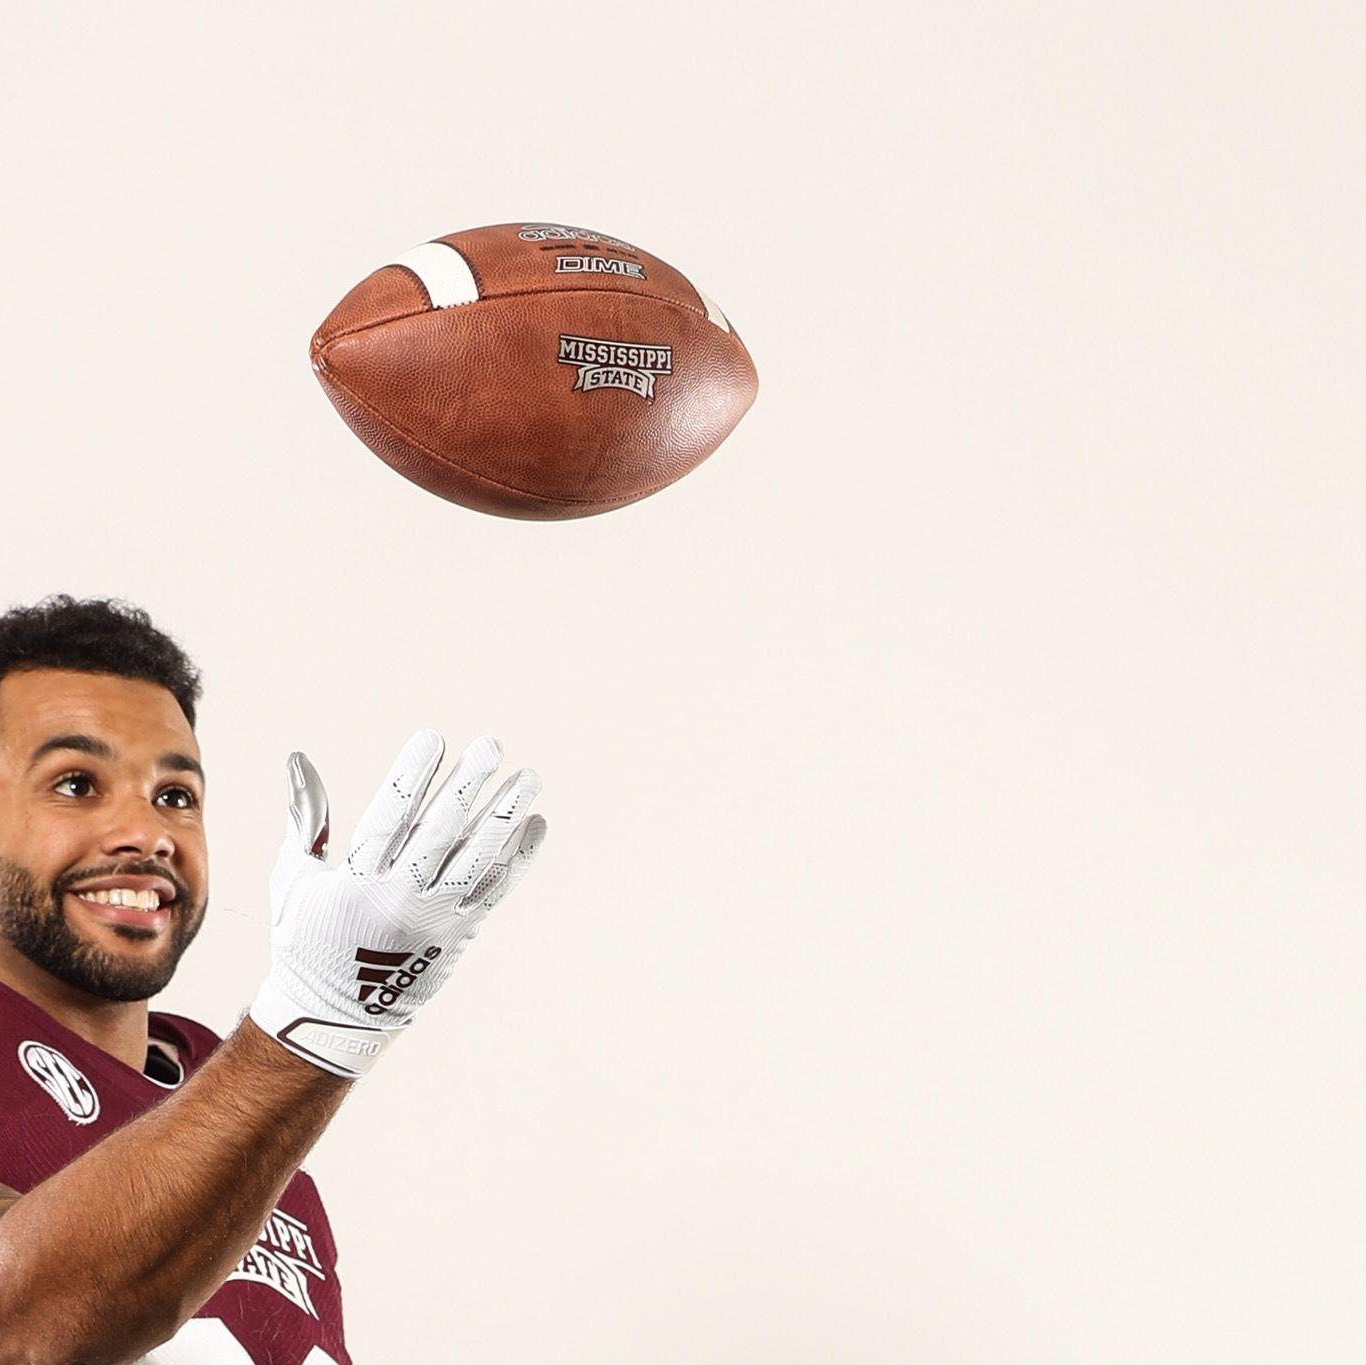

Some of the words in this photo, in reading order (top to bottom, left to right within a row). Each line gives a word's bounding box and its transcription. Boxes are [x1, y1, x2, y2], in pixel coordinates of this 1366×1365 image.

[554, 256, 648, 281] DIME
[559, 339, 672, 369] MISSISSIPPI
[589, 370, 643, 391] STATE
[364, 945, 442, 1016] adidas
[301, 1029, 381, 1057] ADIZERO
[234, 1250, 296, 1298] ATE
